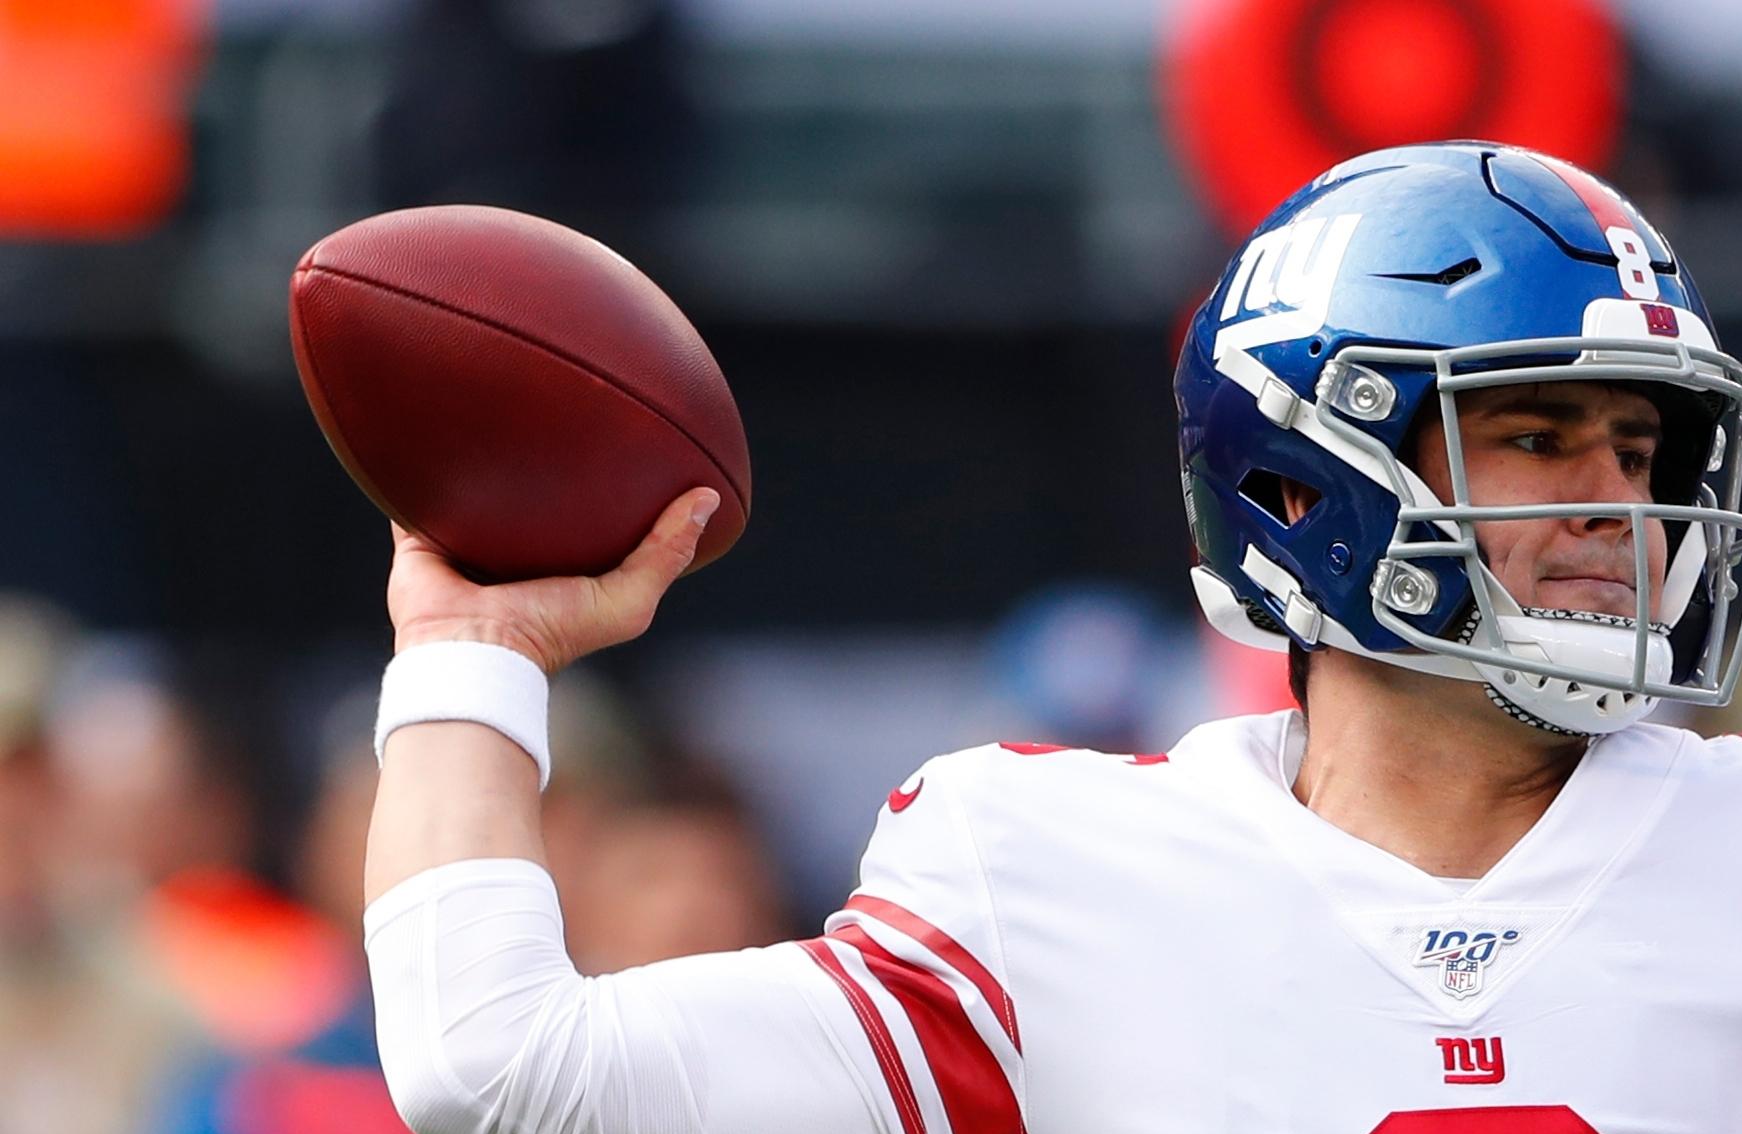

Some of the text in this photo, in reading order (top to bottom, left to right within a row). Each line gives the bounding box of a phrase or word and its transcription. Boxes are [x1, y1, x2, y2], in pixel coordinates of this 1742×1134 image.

[1605, 226, 1659, 301] 8
[1448, 972, 1474, 989] NFL
[1435, 1037, 1505, 1084] ny
